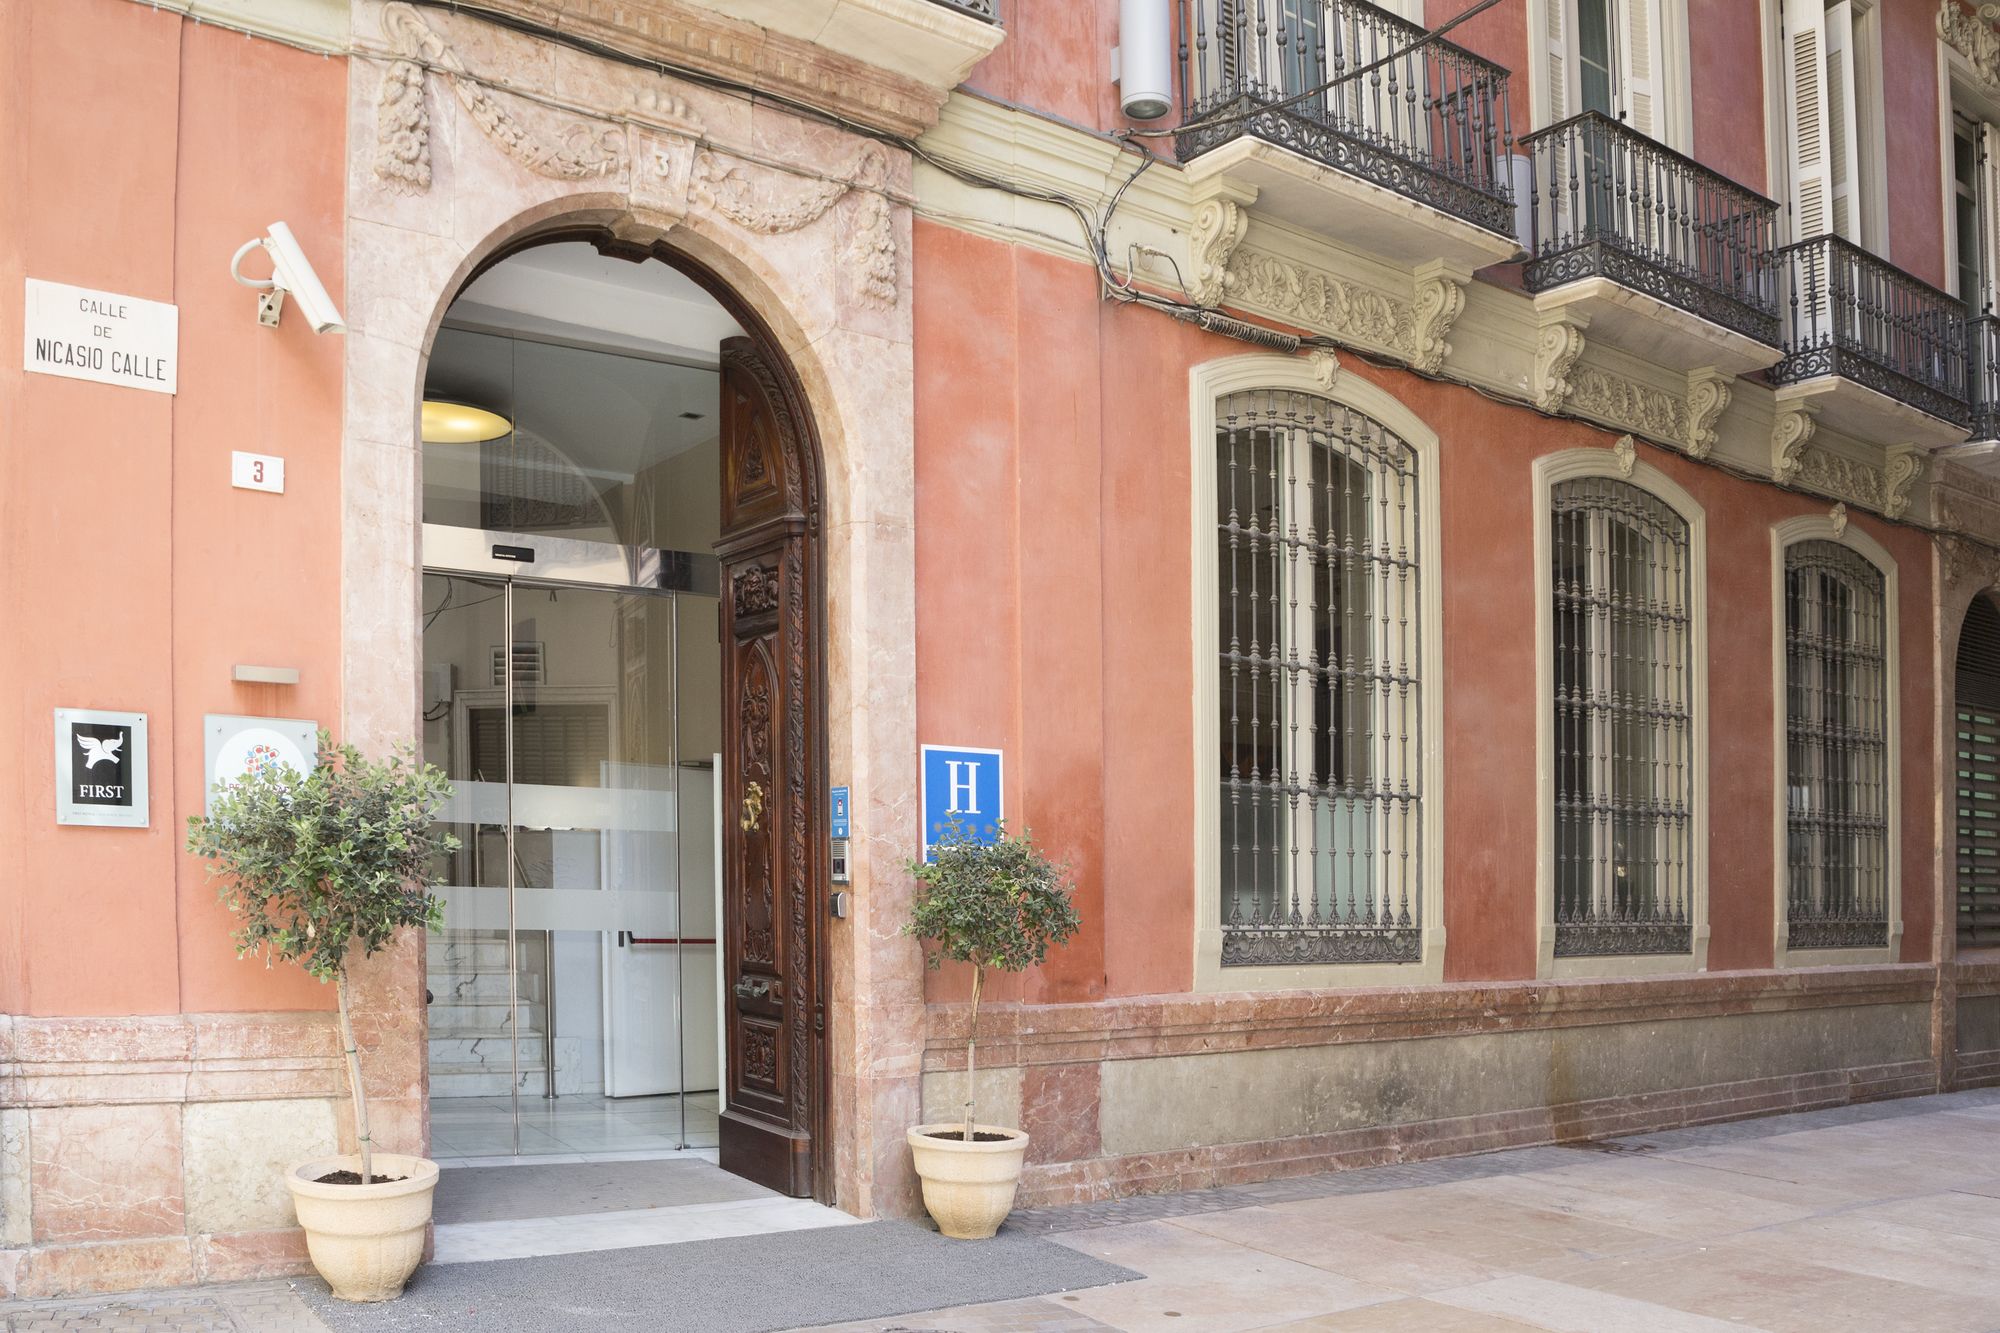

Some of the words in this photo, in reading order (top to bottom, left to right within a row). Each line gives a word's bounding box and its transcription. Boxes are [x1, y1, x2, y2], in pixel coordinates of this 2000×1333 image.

[653, 149, 669, 177] 3
[79, 298, 128, 319] CALLE
[93, 325, 113, 339] DE
[36, 337, 103, 370] NICASIO
[111, 351, 167, 381] CALLE
[253, 460, 264, 483] 3
[79, 784, 125, 798] FIRST
[944, 760, 982, 814] H
